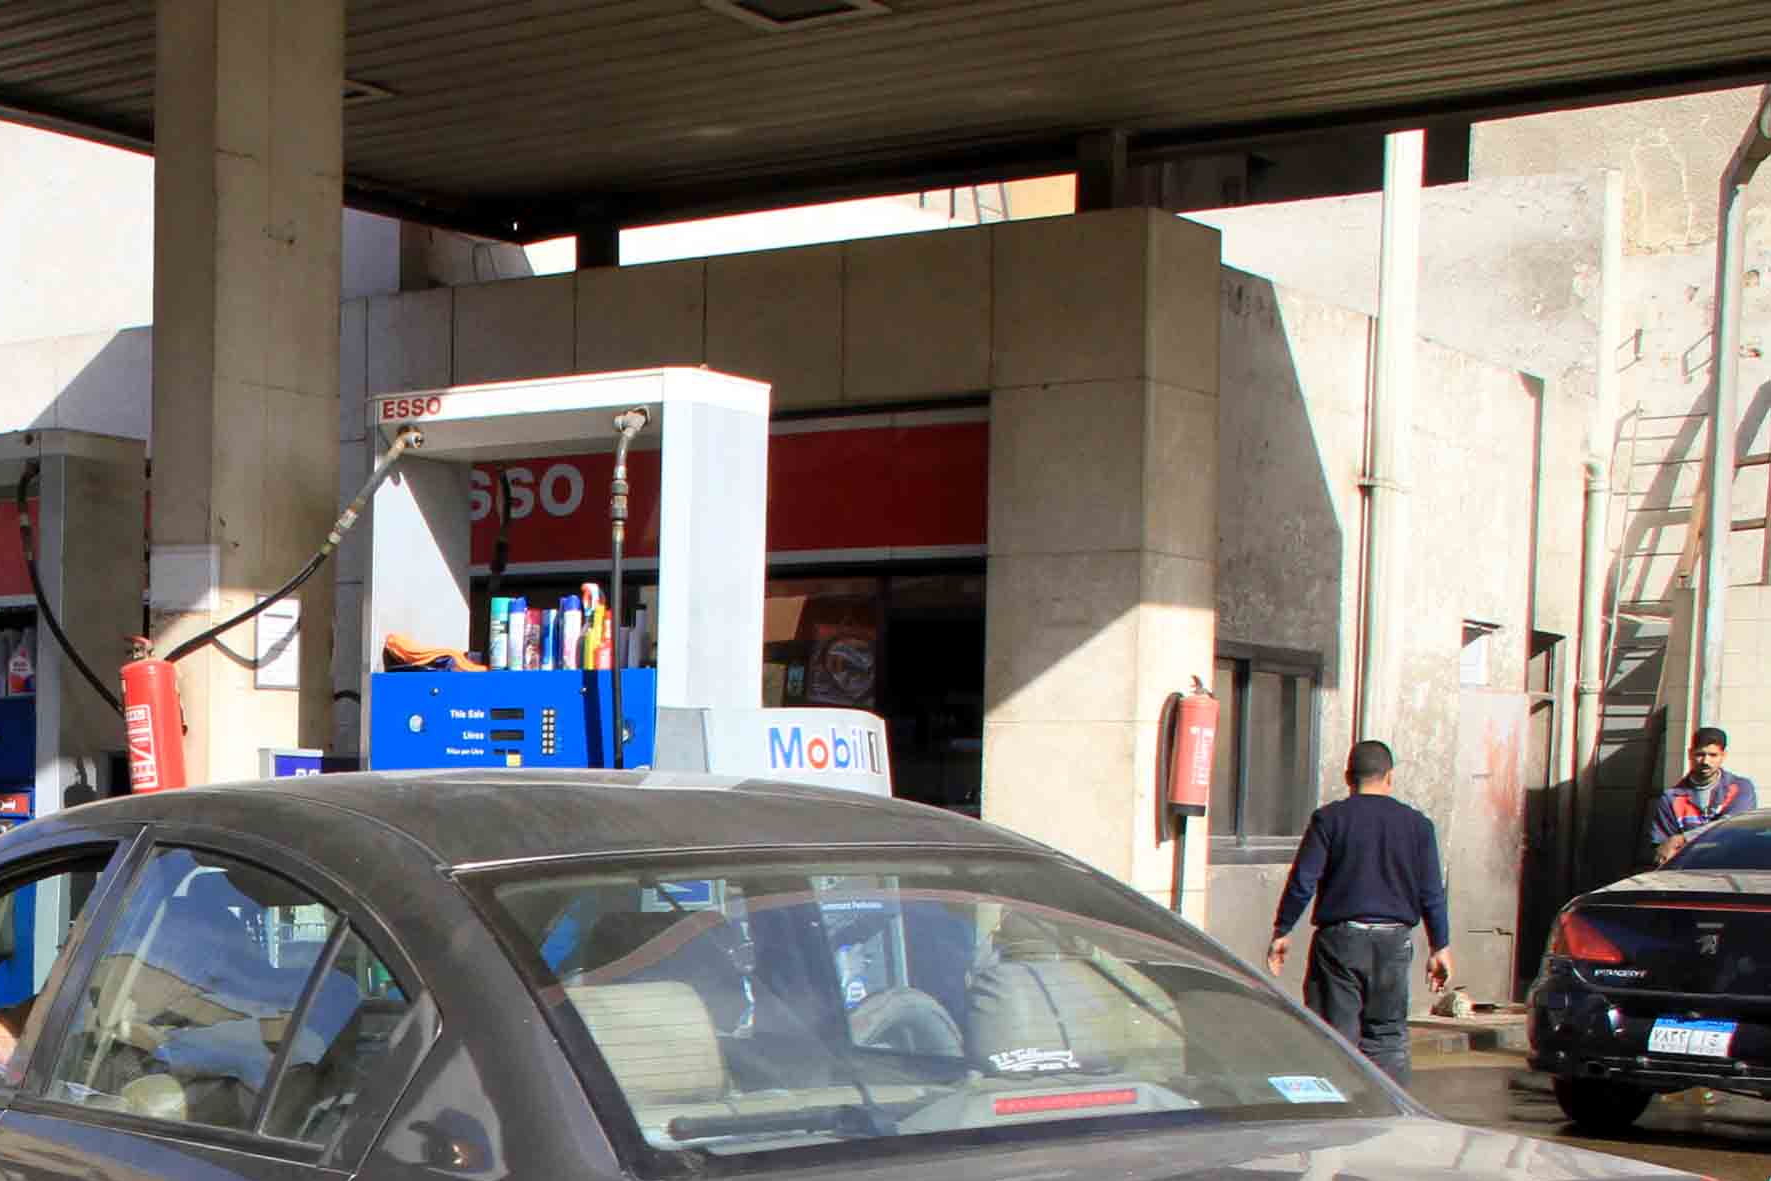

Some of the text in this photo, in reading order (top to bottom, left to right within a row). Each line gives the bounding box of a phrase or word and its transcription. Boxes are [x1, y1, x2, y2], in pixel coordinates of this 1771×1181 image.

[382, 397, 442, 419] ESSO
[469, 463, 584, 520] SSO
[767, 726, 866, 770] Mobil
